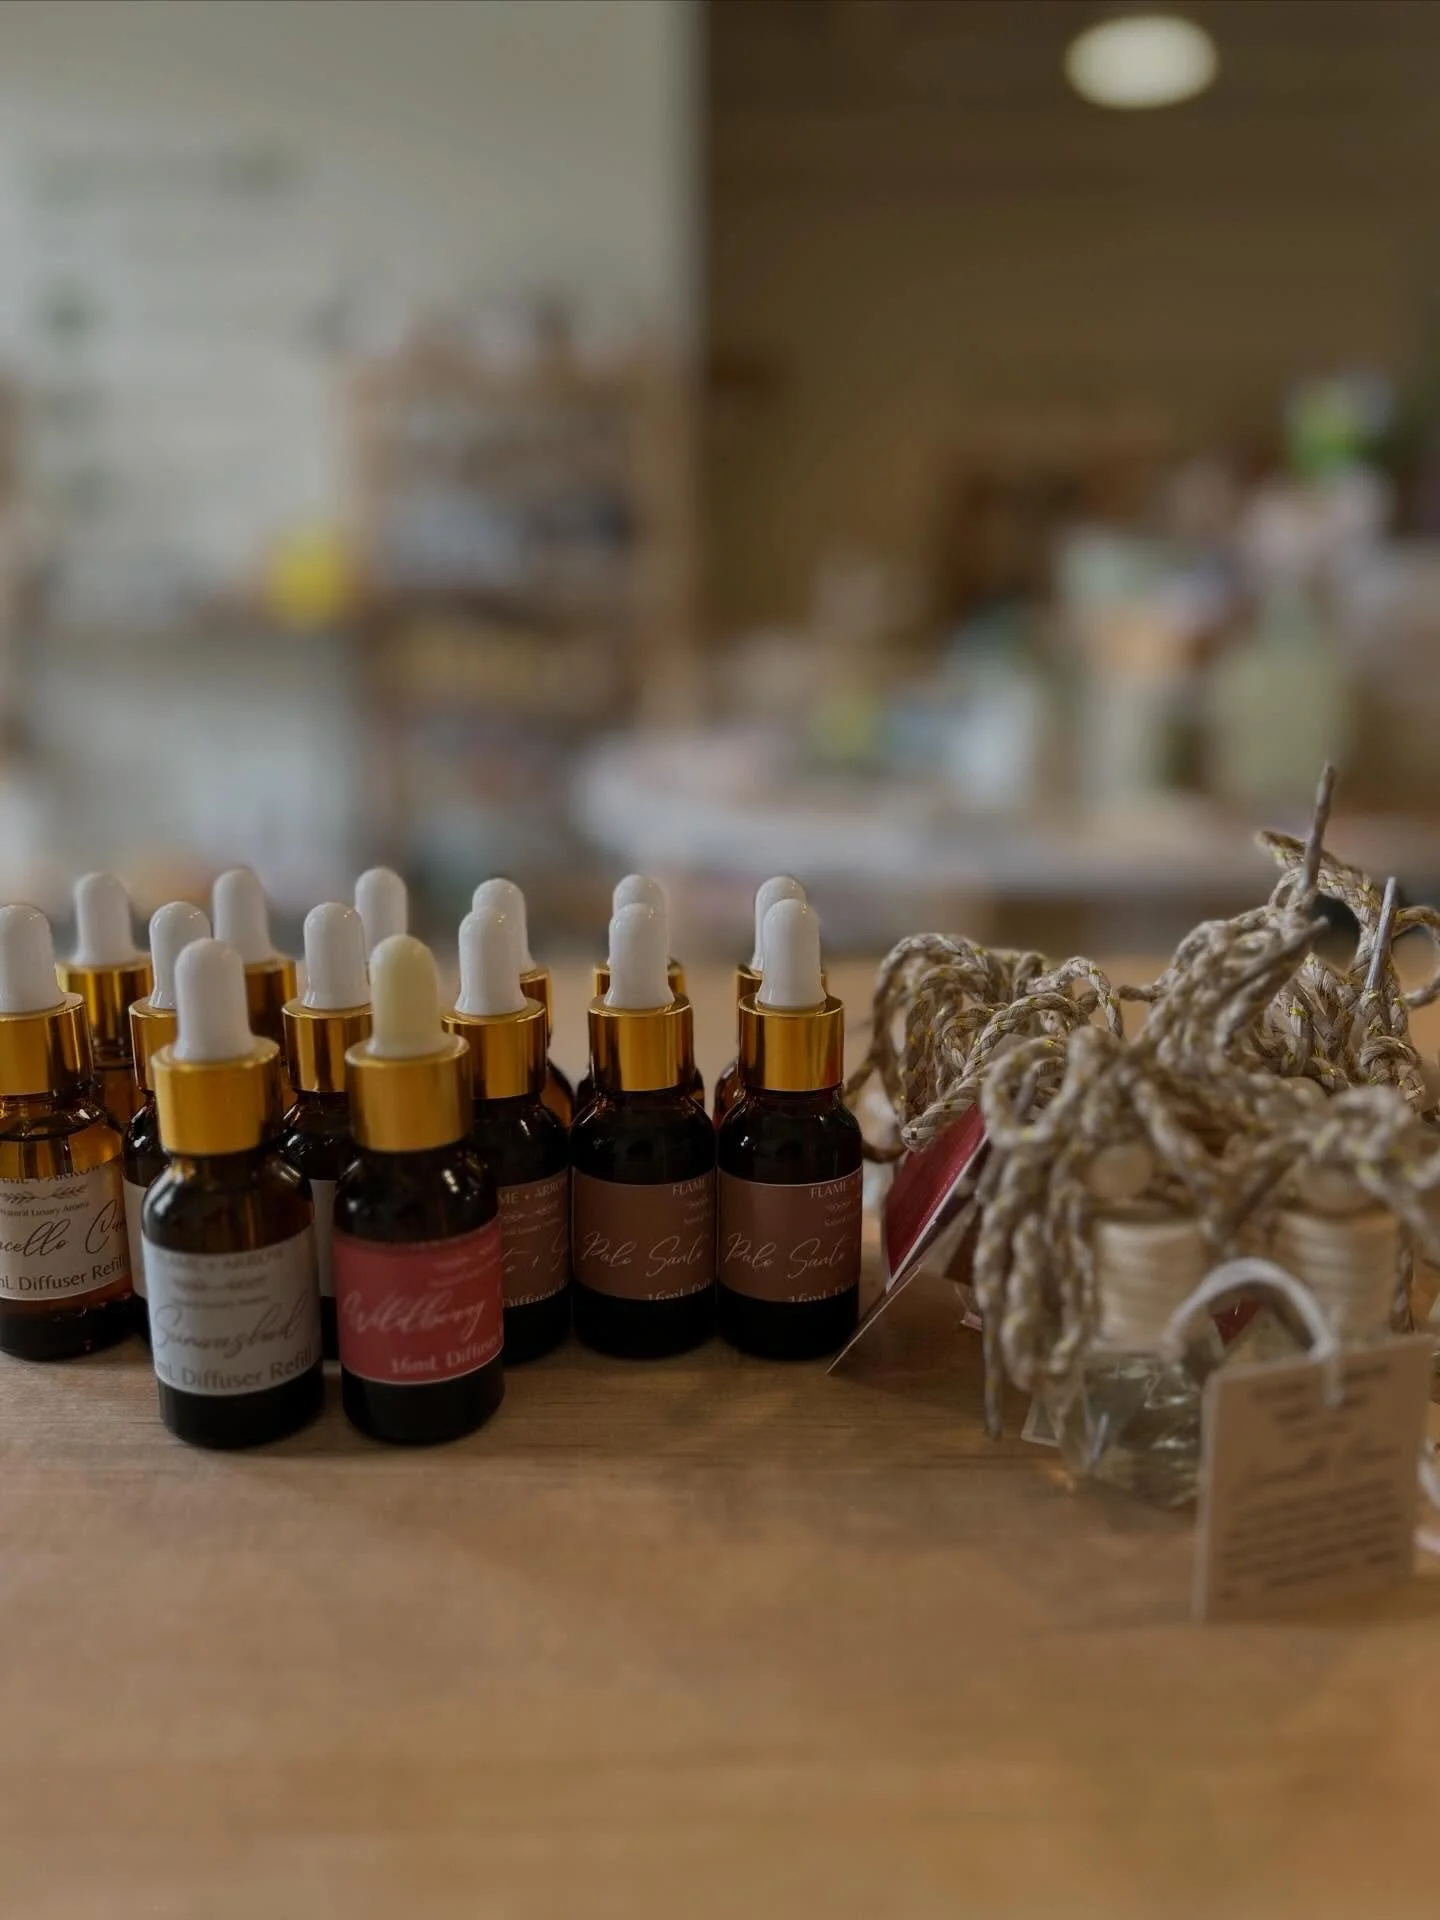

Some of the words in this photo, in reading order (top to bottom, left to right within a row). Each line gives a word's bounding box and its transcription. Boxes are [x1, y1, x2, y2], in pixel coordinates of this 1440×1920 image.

[18, 1272, 88, 1292] Diffuser
[181, 1367, 264, 1390] Diffuser
[270, 1346, 313, 1380] Refill
